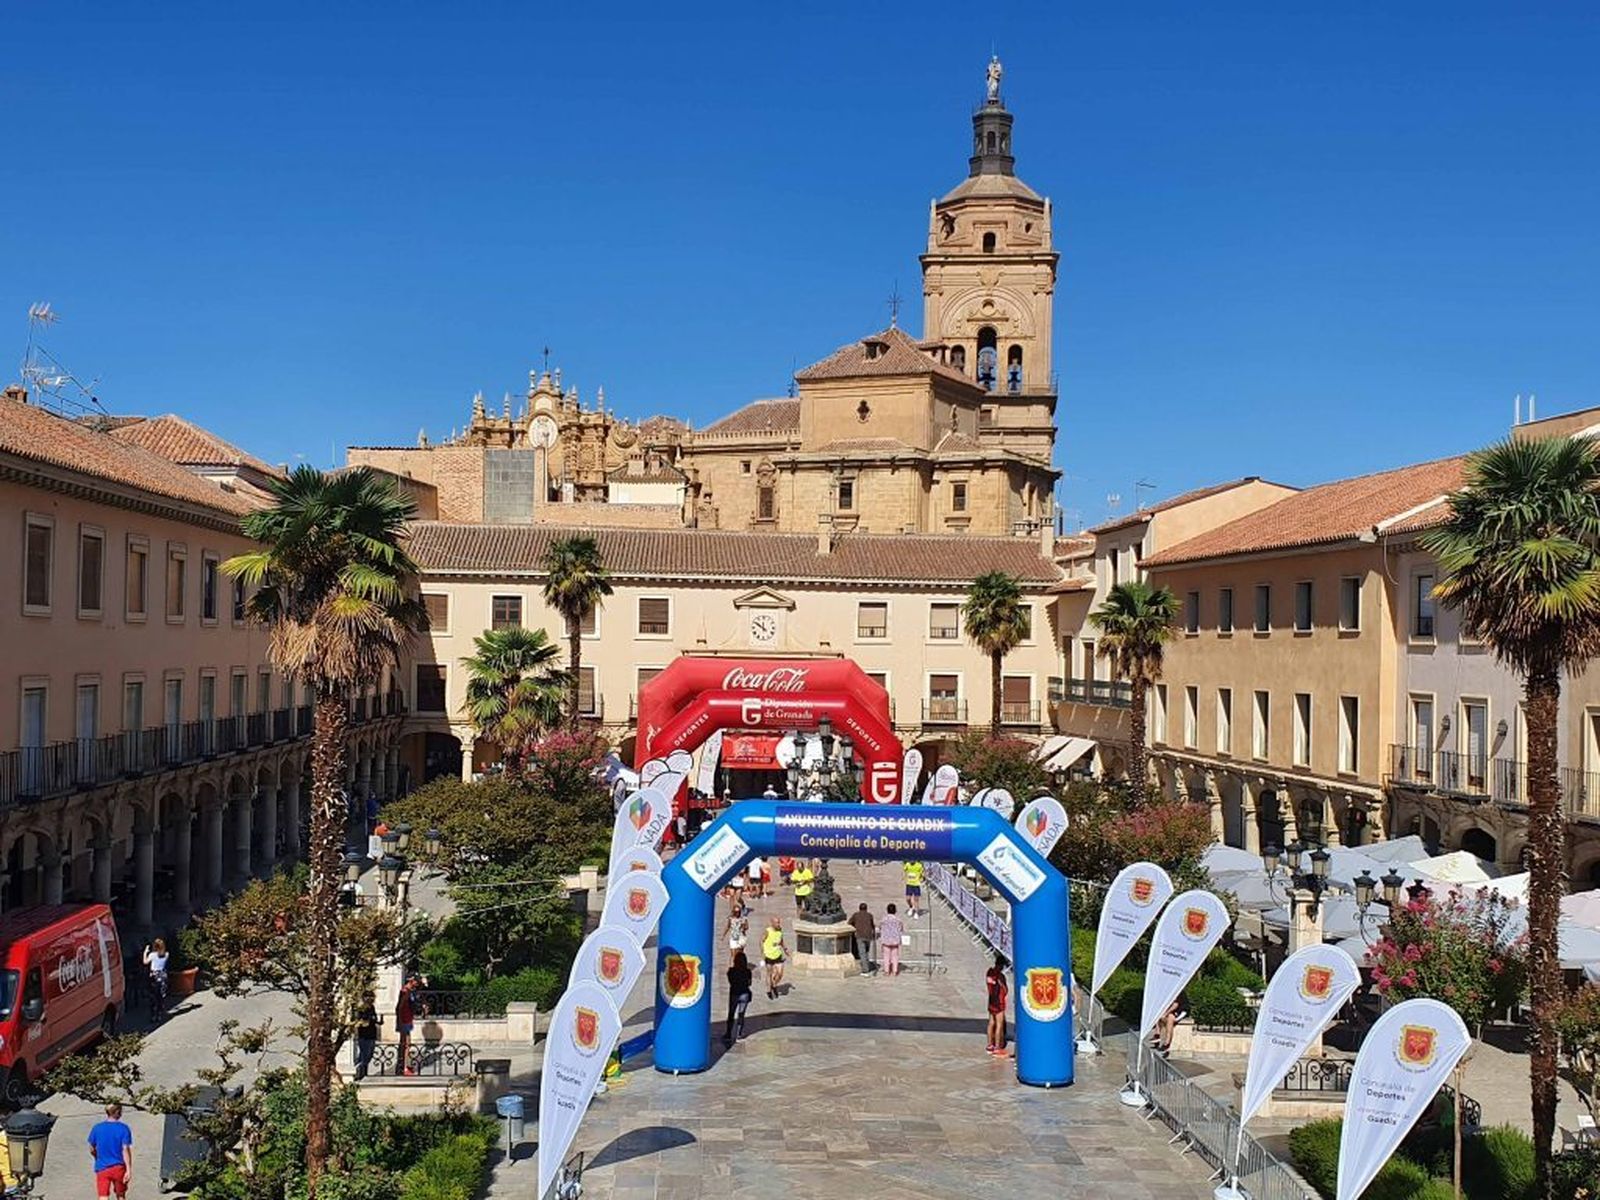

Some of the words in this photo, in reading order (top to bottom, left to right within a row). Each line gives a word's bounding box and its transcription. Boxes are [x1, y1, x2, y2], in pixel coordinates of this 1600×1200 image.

[722, 666, 810, 692] Coca-Cola
[764, 708, 774, 719] de
[775, 709, 813, 719] Granada
[674, 713, 709, 747] DEPORTES
[846, 717, 881, 752] DEPORTES
[782, 814, 876, 830] AYUNTAMIENTO
[879, 817, 897, 830] DE
[898, 817, 945, 832] GUADIX
[800, 833, 861, 849] Concejalía
[863, 835, 877, 848] de
[880, 836, 926, 852] Deporte
[720, 844, 745, 868] deporte
[1366, 1088, 1406, 1101] Deportes
